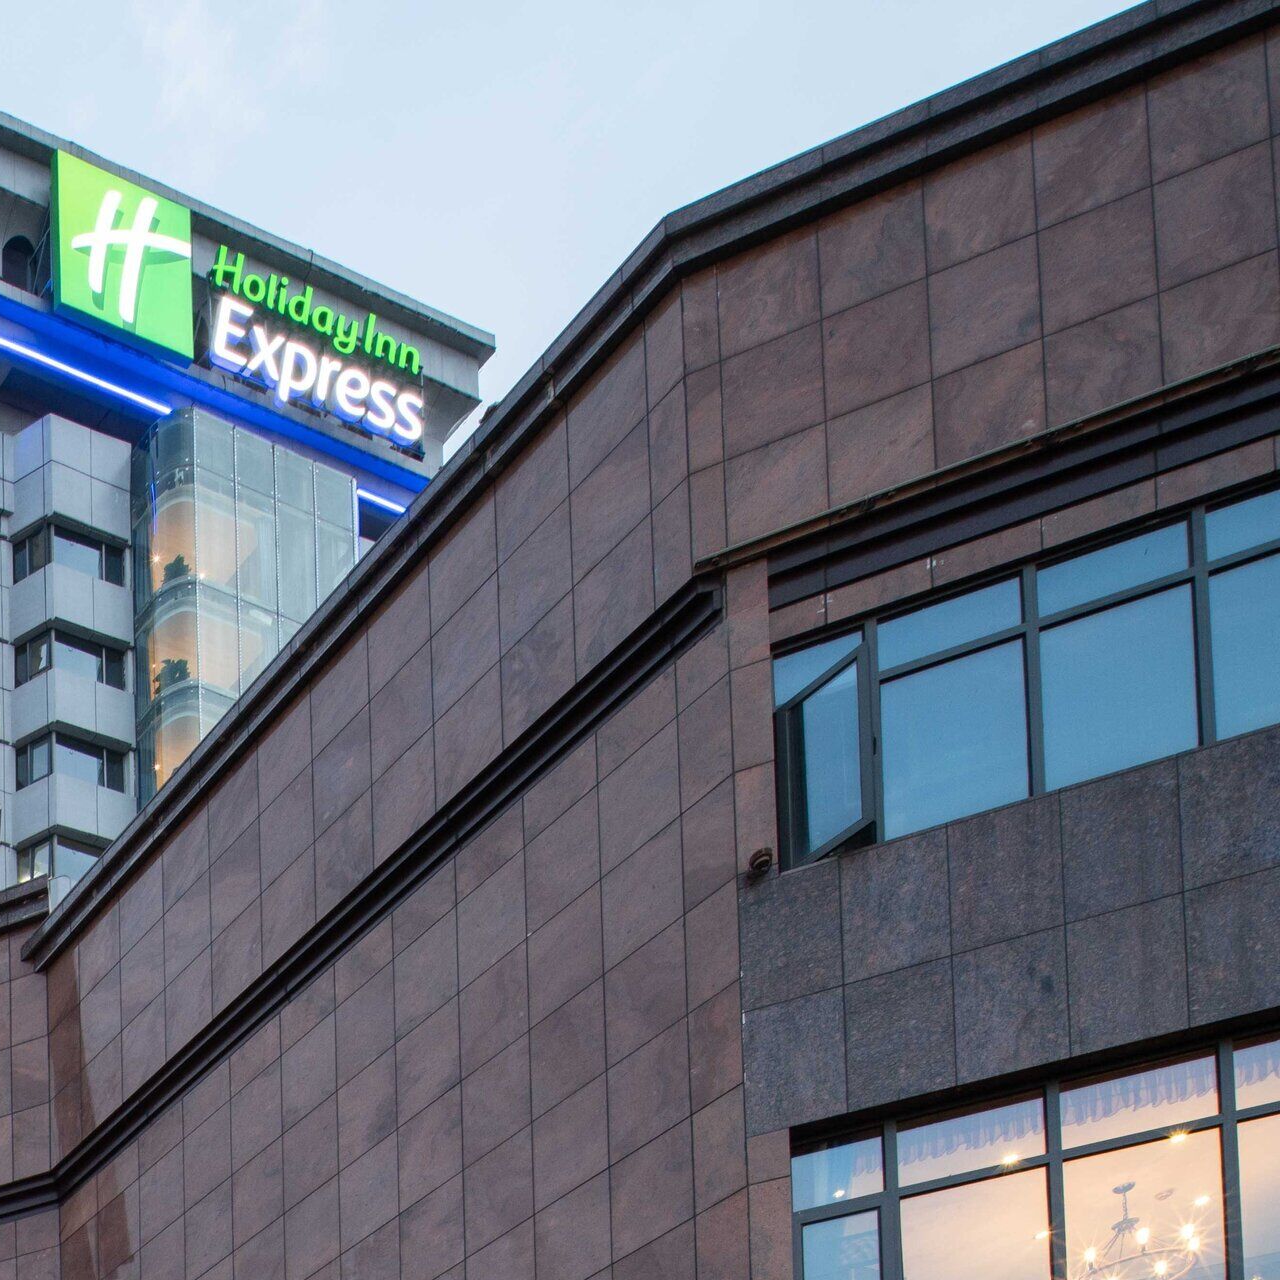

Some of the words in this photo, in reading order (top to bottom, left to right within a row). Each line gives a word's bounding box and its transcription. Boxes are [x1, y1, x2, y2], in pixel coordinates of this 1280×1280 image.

[211, 245, 362, 356] Holiday
[364, 312, 422, 375] Inn
[211, 296, 424, 442] Express
